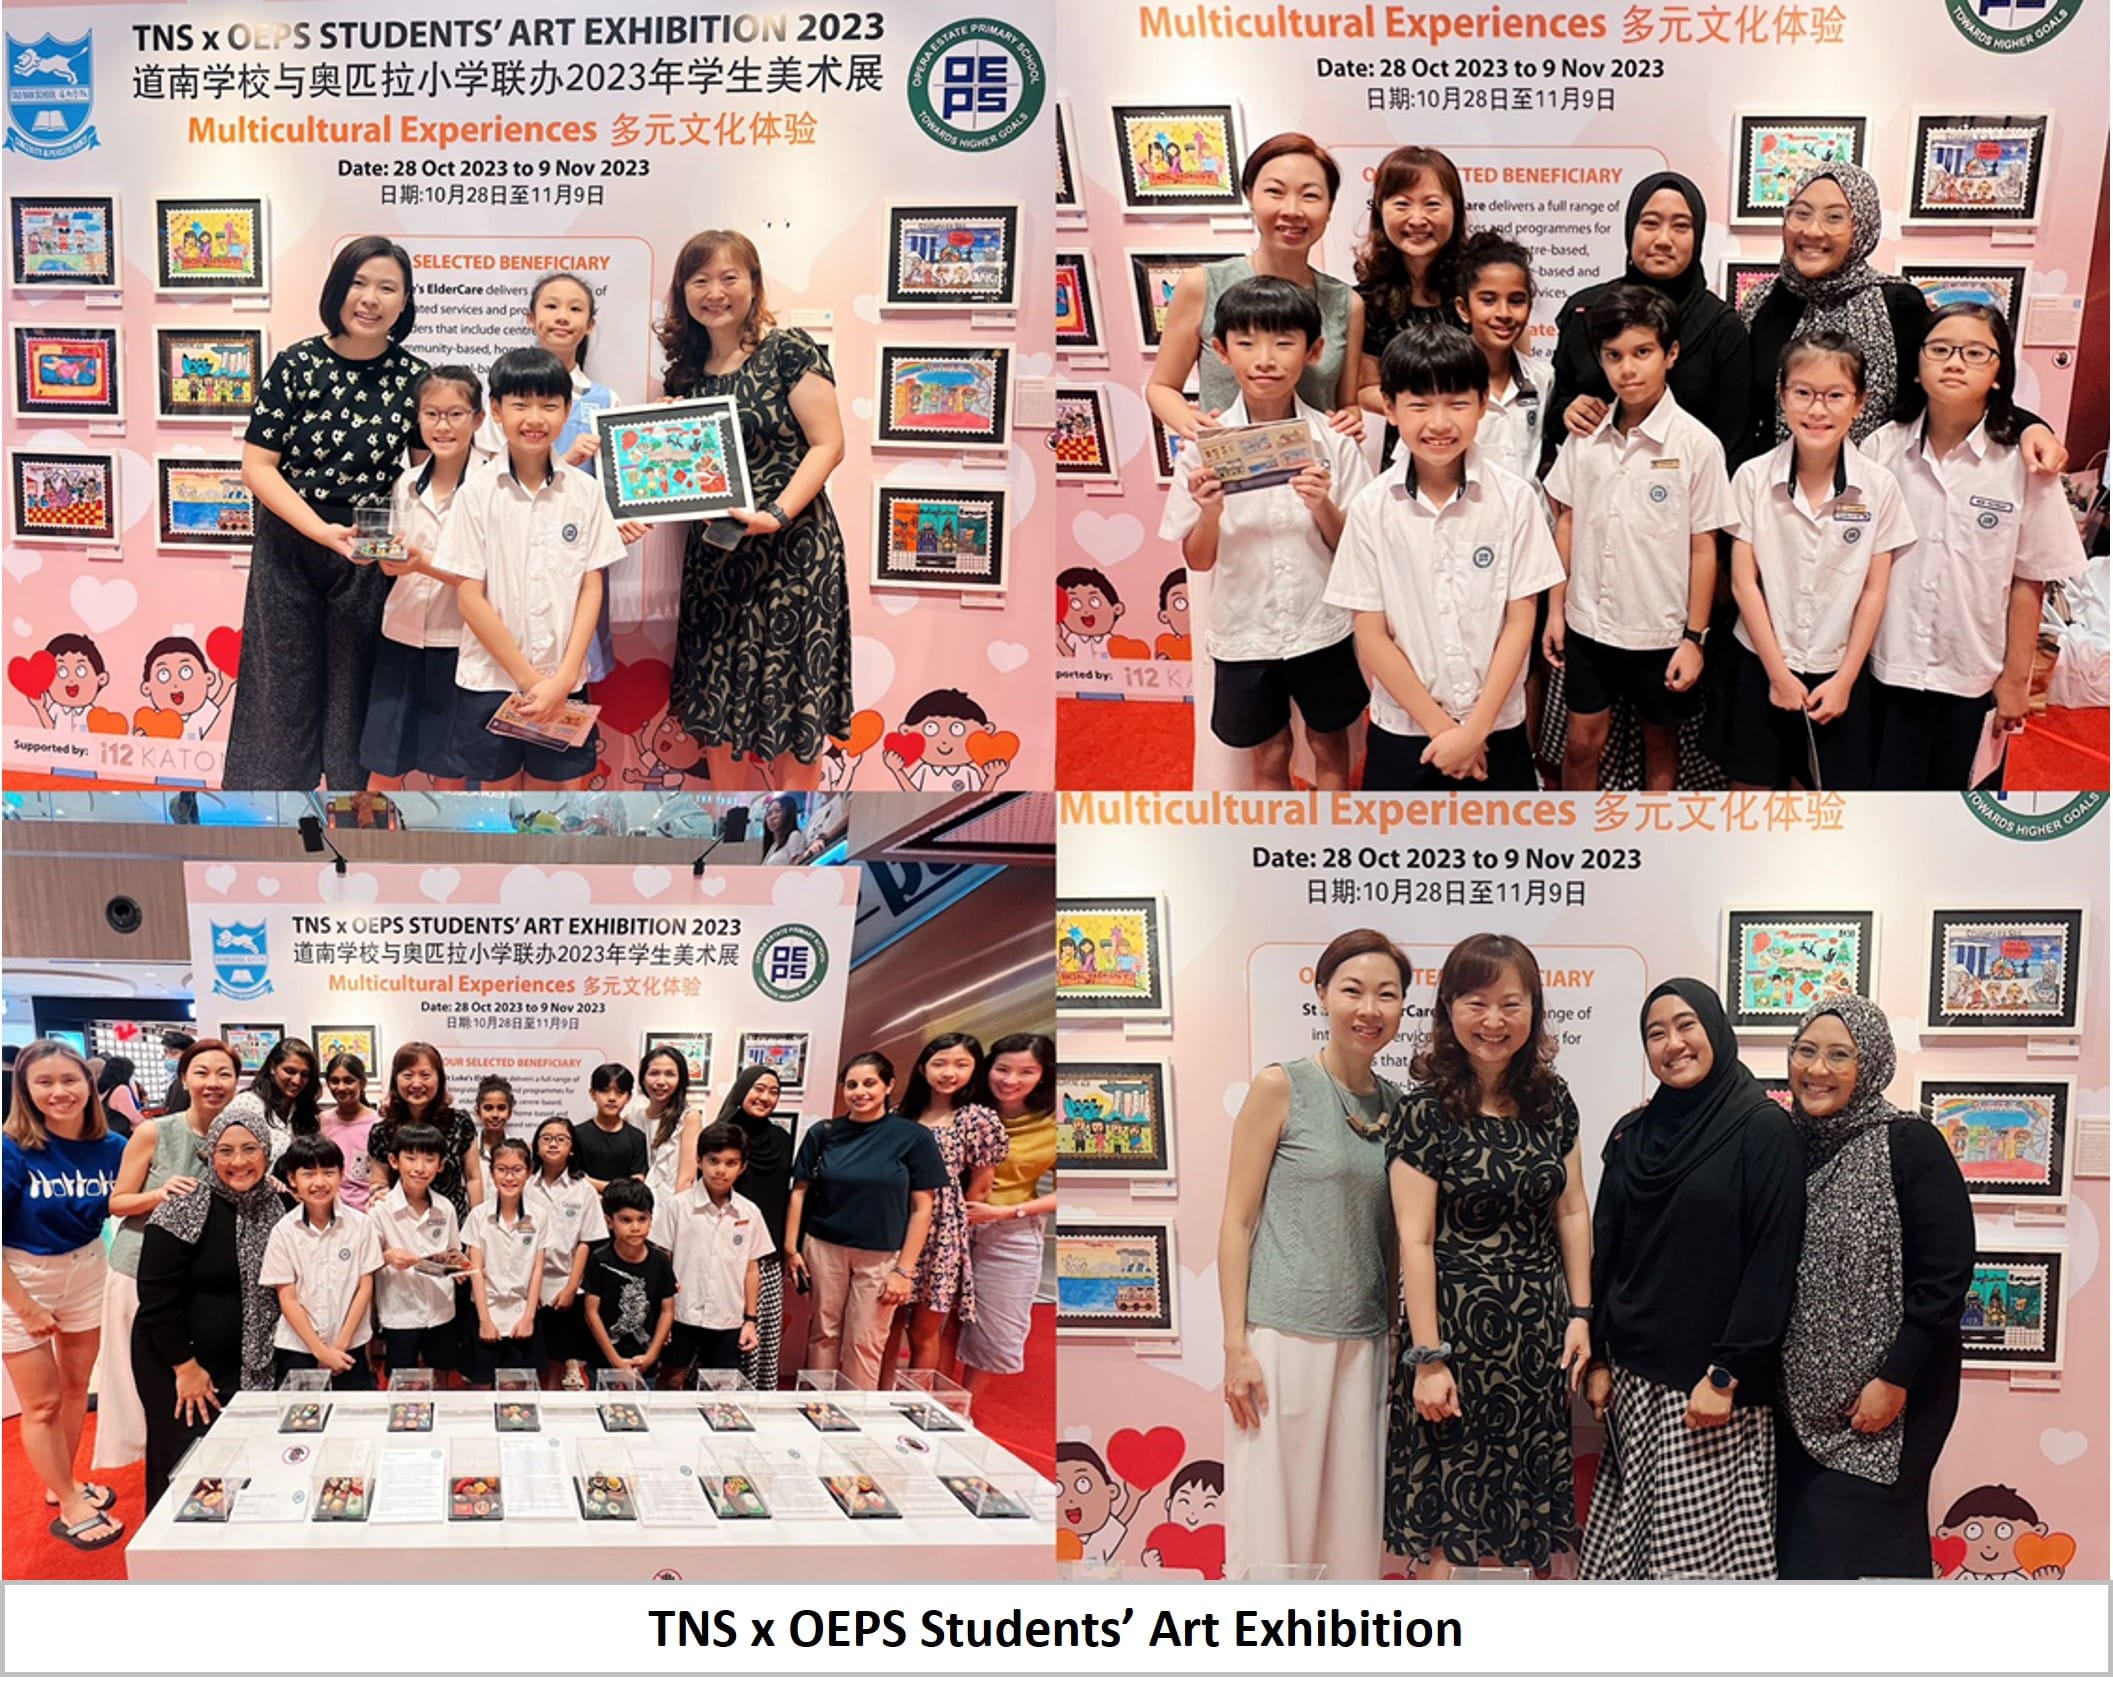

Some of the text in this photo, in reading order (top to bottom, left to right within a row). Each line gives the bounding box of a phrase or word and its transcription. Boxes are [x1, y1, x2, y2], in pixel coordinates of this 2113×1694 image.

[132, 24, 193, 51] TNS
[202, 30, 220, 51] x
[228, 22, 310, 51] OEPS
[508, 18, 576, 46] ART
[585, 14, 786, 46] EXHIBITION
[797, 13, 884, 42] 2023
[1140, 4, 1847, 47] Multicultural Experiences 多元文化体验
[1953, 5, 2068, 50] TOWARDS HIGHER GOALS
[912, 23, 1040, 87] OPERA ESTATE PRIMARY SCHOOL
[132, 54, 884, 99] 道南学校与奥匹拉小学联办2023年学生美术展
[1317, 58, 1665, 78] Date: 28 Oct 2023 to 9 Nov 2023
[188, 111, 818, 150] Multicultural Experiences 多元文化体验
[919, 111, 1028, 149] TOWARDS HIGHER GOALS
[338, 159, 650, 177] Date: 28 Oct 2023 to 9 Nov 2023
[1503, 167, 1623, 184] BENEFICIARY
[1488, 199, 1535, 212] delivers
[1538, 202, 1545, 212] a
[1547, 199, 1568, 212] full
[1570, 202, 1604, 215] range
[1607, 199, 1620, 213] of
[1515, 223, 1593, 238] programmes
[1594, 222, 1611, 235] for
[413, 254, 611, 271] SELECTED BENEFICIARY
[1578, 266, 1600, 277] and
[427, 283, 484, 296] ElderCare
[485, 284, 529, 296] delivers
[595, 284, 608, 297] of
[440, 304, 484, 315] services
[485, 304, 507, 316] and
[436, 323, 458, 335] that
[461, 323, 501, 335] include
[1096, 669, 1113, 681] by:
[1124, 667, 1159, 688] i12
[14, 738, 89, 757] Supported by:
[101, 741, 134, 767] i12
[1061, 791, 1846, 834] Multicultural Experiences 多元文化体验
[1968, 791, 2100, 837] TOWARDS HIGHER GOALS
[1252, 847, 1641, 870] Date: 28 Oct 2023 to 9 Nov 2023
[292, 916, 330, 934] TNS
[337, 922, 347, 934] x
[352, 915, 404, 934] OEPS
[523, 917, 564, 935] ART
[569, 917, 687, 935] EXHIBITION
[692, 917, 741, 936] 2023
[329, 974, 702, 997] Multicultural Experiences 多元文化体验
[420, 1001, 606, 1013] Date: 28 Oct 2023 to 9 Nov 2023
[1302, 1003, 1316, 1016] St
[1577, 1006, 1592, 1020] of
[1563, 1031, 1581, 1045] for
[444, 1057, 581, 1068] OUR SELECTED BENEFICIARY
[1381, 1054, 1408, 1067] that
